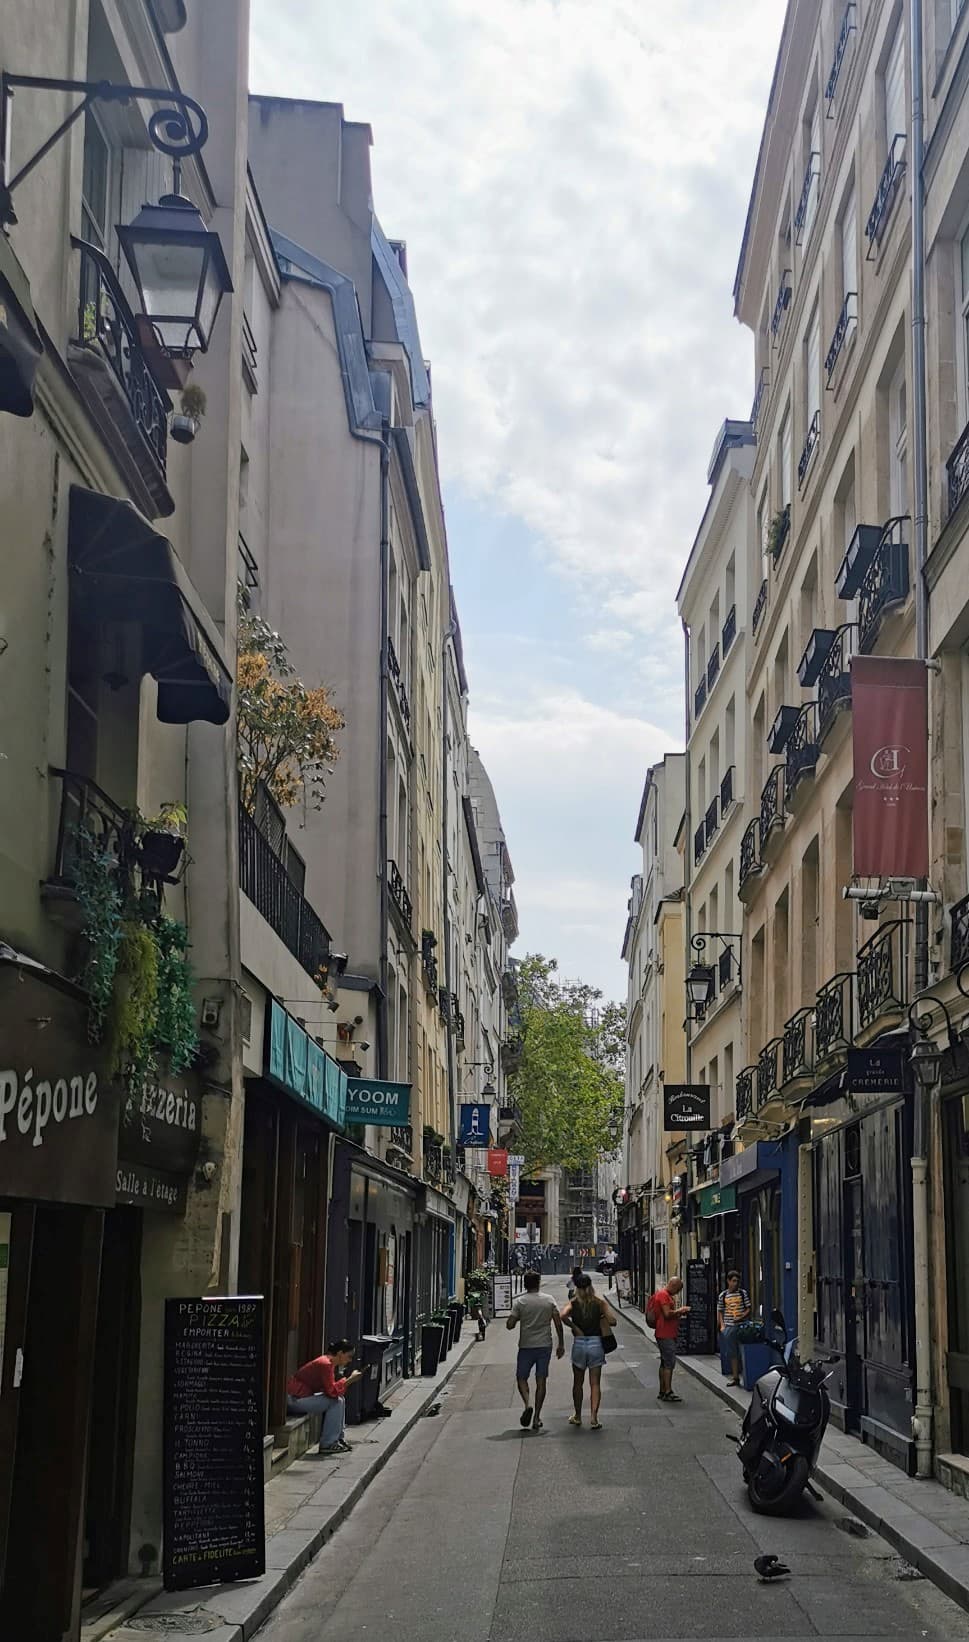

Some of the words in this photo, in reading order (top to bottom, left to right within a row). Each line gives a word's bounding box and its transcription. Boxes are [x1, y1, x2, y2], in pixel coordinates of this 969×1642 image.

[347, 1088, 399, 1105] YOOM
[0, 1067, 98, 1147] Pépone
[345, 1105, 359, 1113] DIM
[360, 1107, 378, 1115] SUM
[682, 1104, 692, 1112] La
[670, 1114, 705, 1122] Citrouille
[115, 1170, 140, 1195] Salle
[179, 1303, 223, 1314] PEPONE
[189, 1314, 240, 1328] PIZZA
[183, 1328, 230, 1337] EMPORTER
